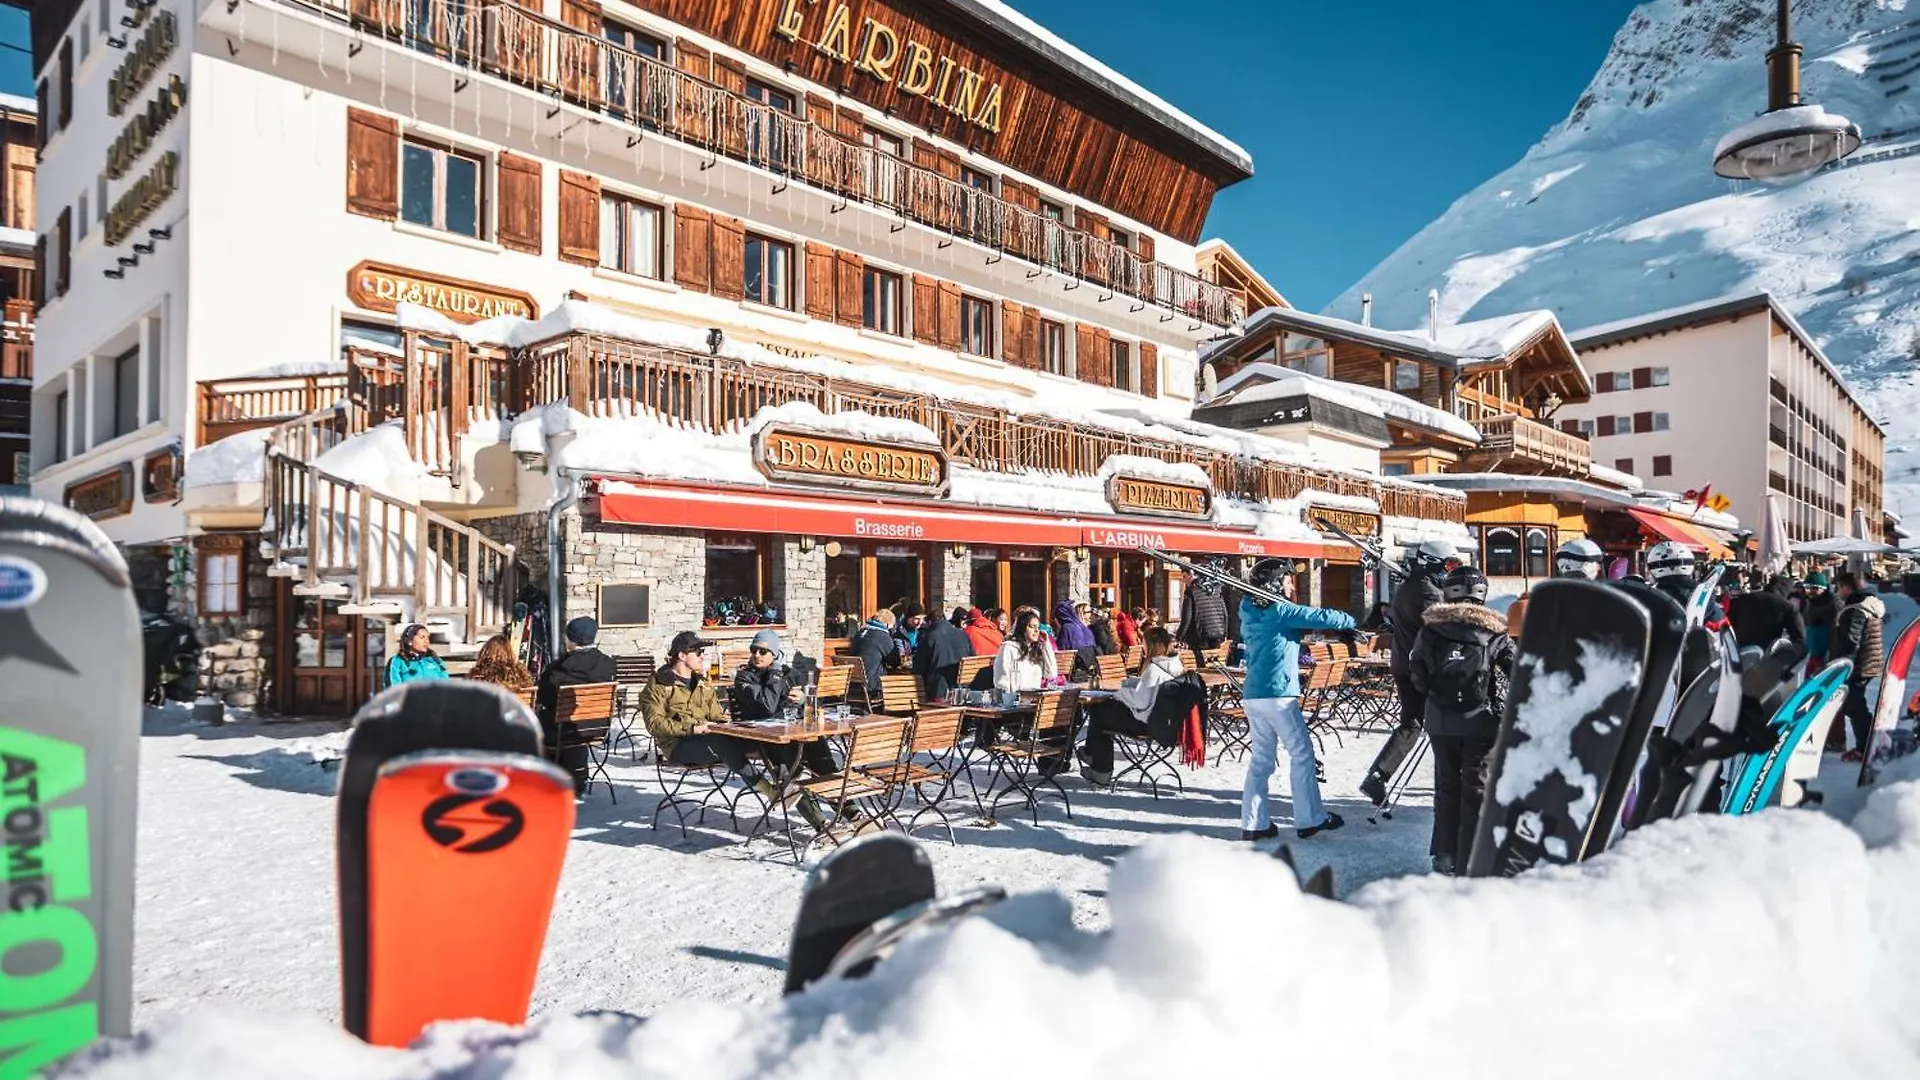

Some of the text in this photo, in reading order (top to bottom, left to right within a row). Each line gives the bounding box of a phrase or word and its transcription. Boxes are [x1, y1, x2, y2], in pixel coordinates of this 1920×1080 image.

[776, 0, 1002, 134] LARBINA
[374, 275, 518, 318] RESTAURANT
[777, 438, 930, 482] BRASSERIE
[1126, 483, 1195, 510] PIZZERIA
[854, 518, 923, 538] Brasserie
[1089, 529, 1166, 550] L'ARBINA
[1743, 730, 1790, 813] DYNASTAR
[1, 752, 48, 914] ATOMIC
